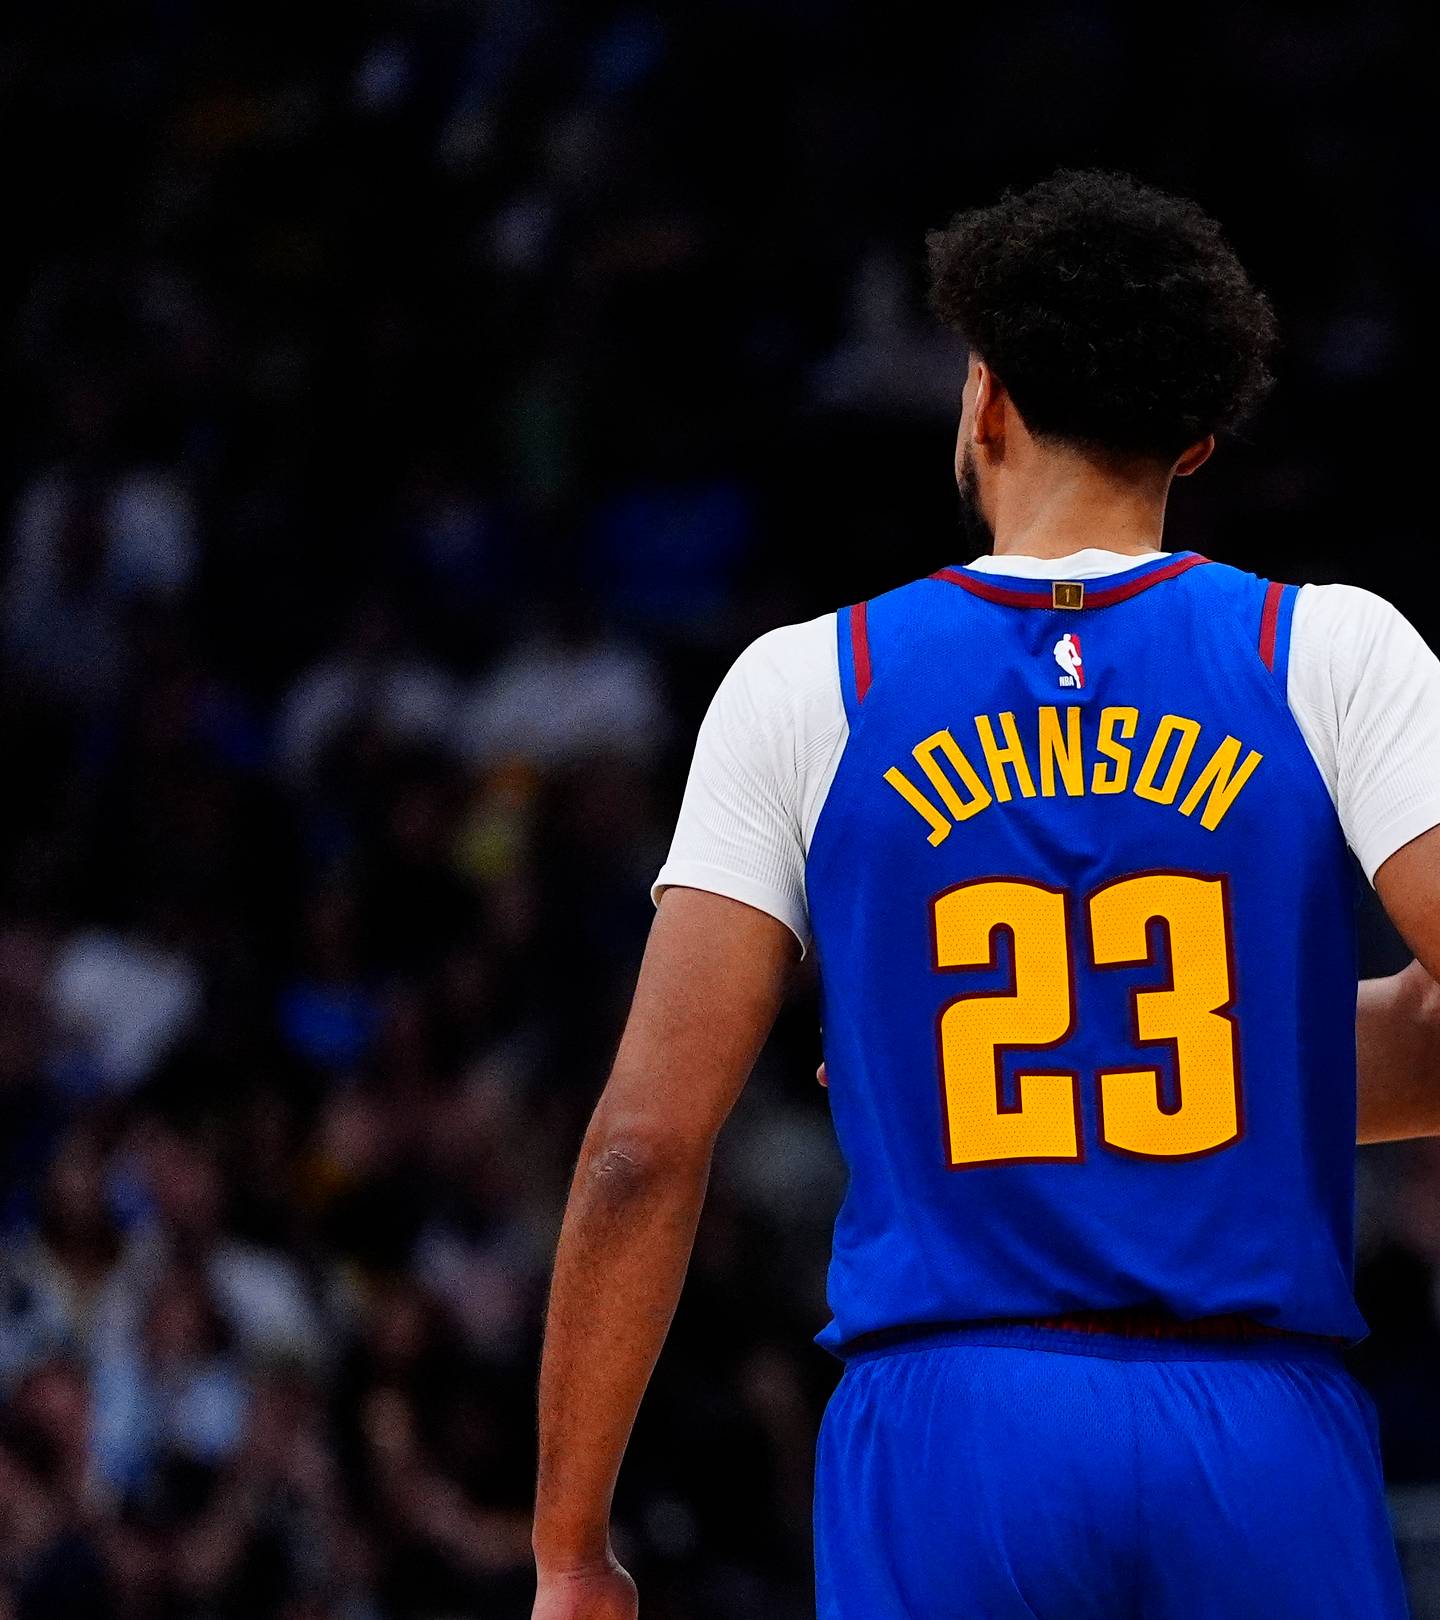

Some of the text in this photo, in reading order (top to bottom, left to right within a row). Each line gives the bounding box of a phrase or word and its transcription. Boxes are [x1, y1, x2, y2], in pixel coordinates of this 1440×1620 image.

[1059, 676, 1075, 687] NBA
[884, 706, 1262, 846] JOHNSON
[932, 873, 1241, 1166] 23
